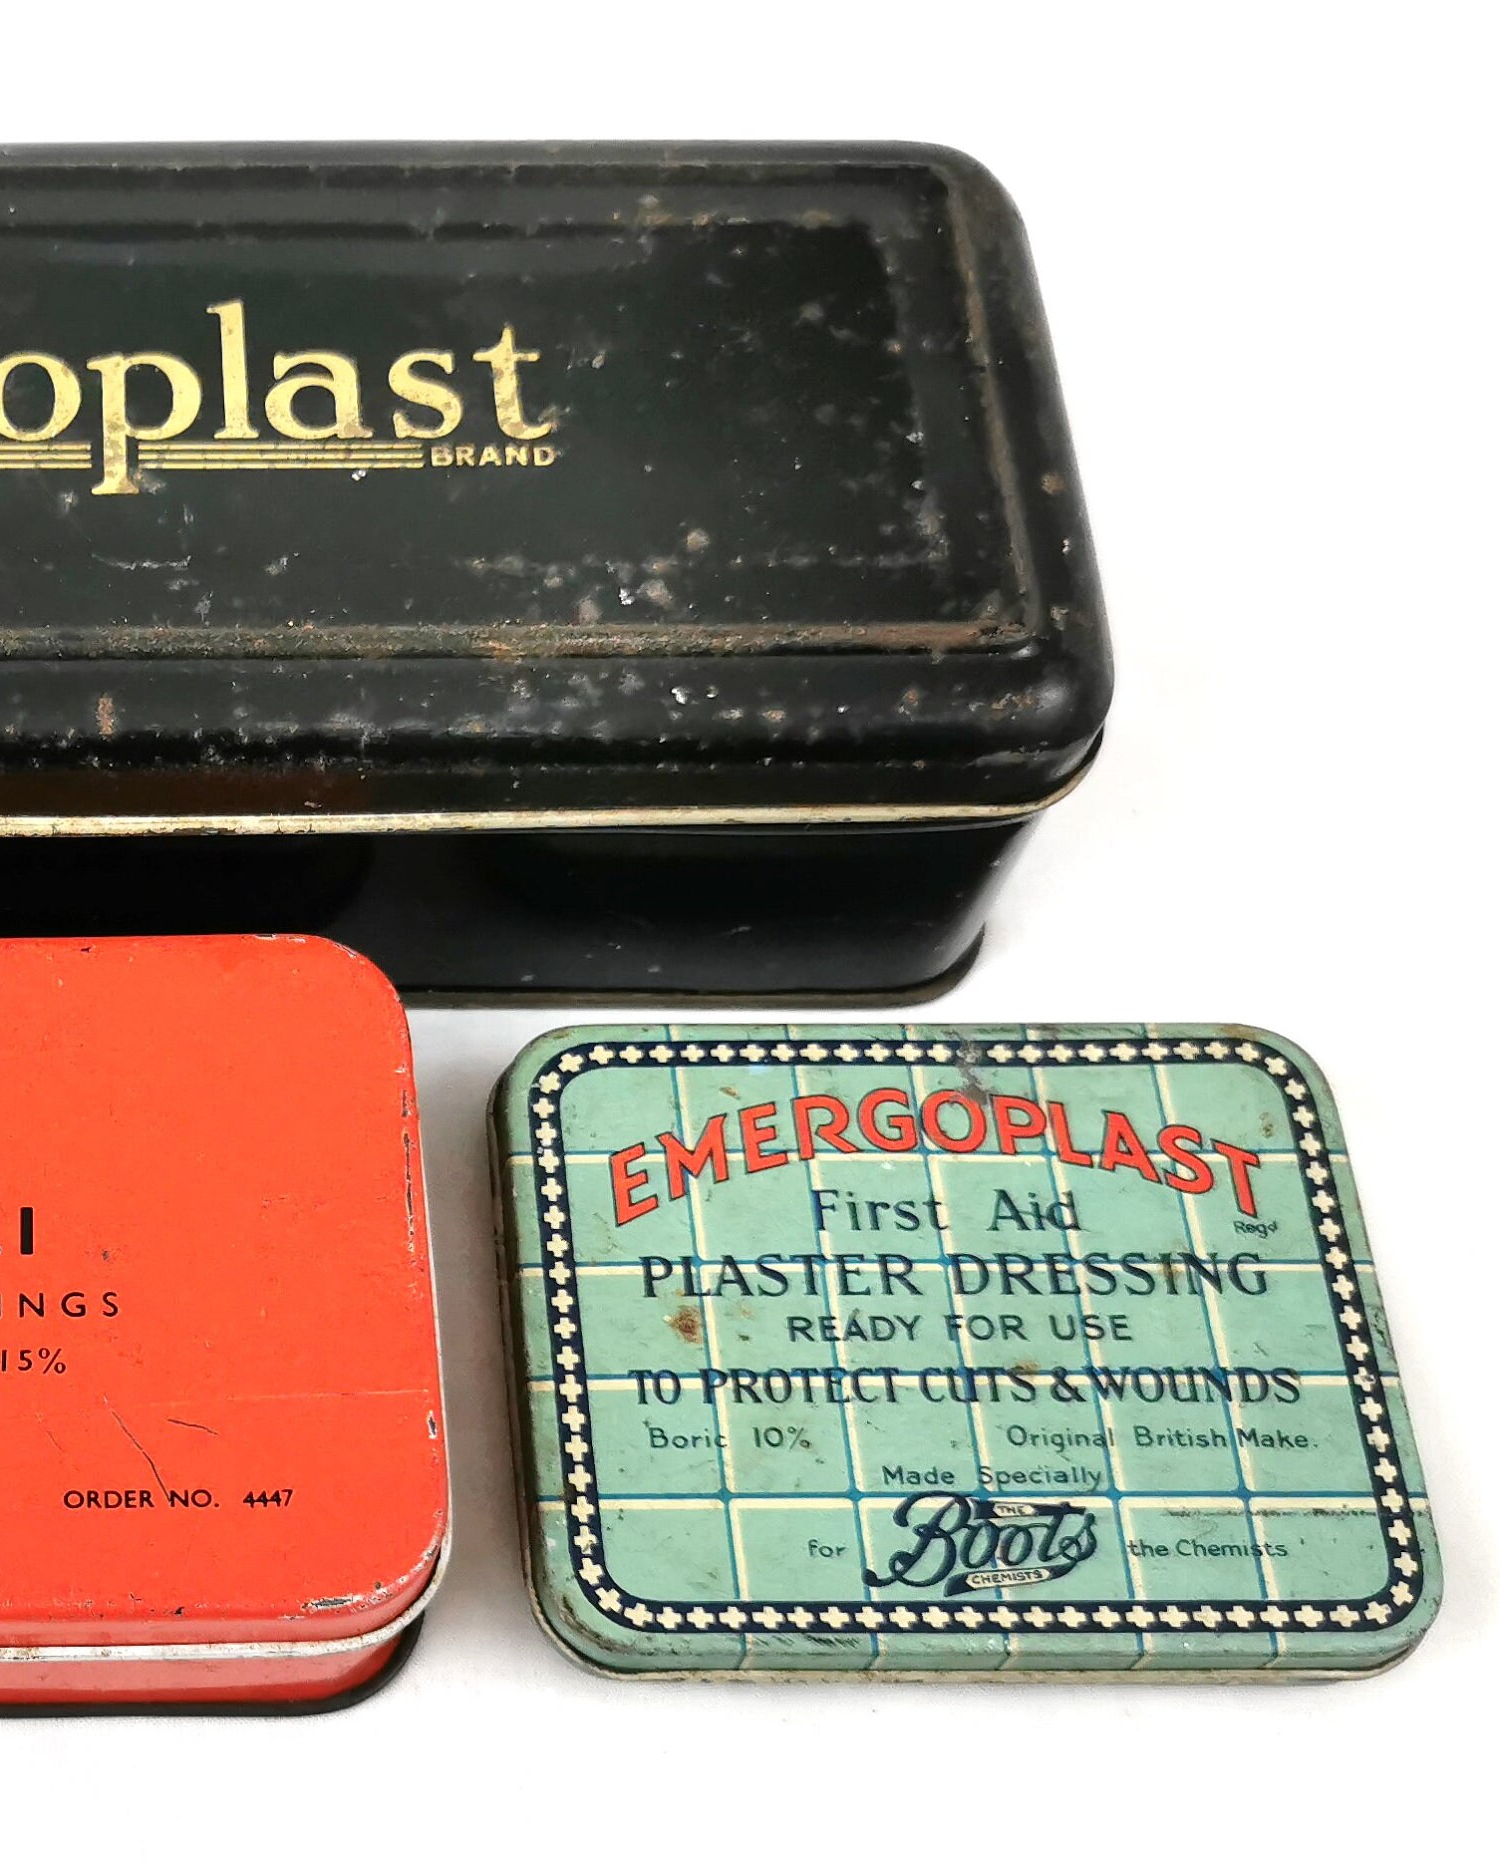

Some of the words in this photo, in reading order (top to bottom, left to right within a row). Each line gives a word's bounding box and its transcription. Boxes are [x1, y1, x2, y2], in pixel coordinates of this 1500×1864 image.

[430, 447, 556, 468] BRAND
[608, 1087, 1261, 1227] EMERGOPLAST
[815, 1188, 951, 1232] First
[987, 1187, 1082, 1232] Aid
[640, 1254, 932, 1298] PLASTER
[952, 1252, 1268, 1297] DRESSING
[787, 1315, 917, 1342] READY
[947, 1314, 1030, 1341] FOR
[1052, 1314, 1133, 1341] USE
[628, 1369, 682, 1404] TO
[700, 1368, 902, 1404] PROTECT
[920, 1366, 1037, 1403] CUTS
[647, 1426, 727, 1450] Boric
[753, 1425, 811, 1450] 10%
[1007, 1424, 1115, 1450] Original
[1134, 1423, 1227, 1448] British
[1237, 1424, 1319, 1448] Make.
[882, 1465, 955, 1486] Made
[977, 1465, 1101, 1492] Specially
[63, 1489, 155, 1509] ORDER
[168, 1488, 220, 1509] NO.
[242, 1488, 294, 1509] 4447
[997, 1505, 1027, 1516] THE
[862, 1490, 1098, 1592] Boots
[1127, 1539, 1169, 1557] the
[1175, 1538, 1288, 1558] Chemists
[971, 1569, 1045, 1586] CHEMISTS
